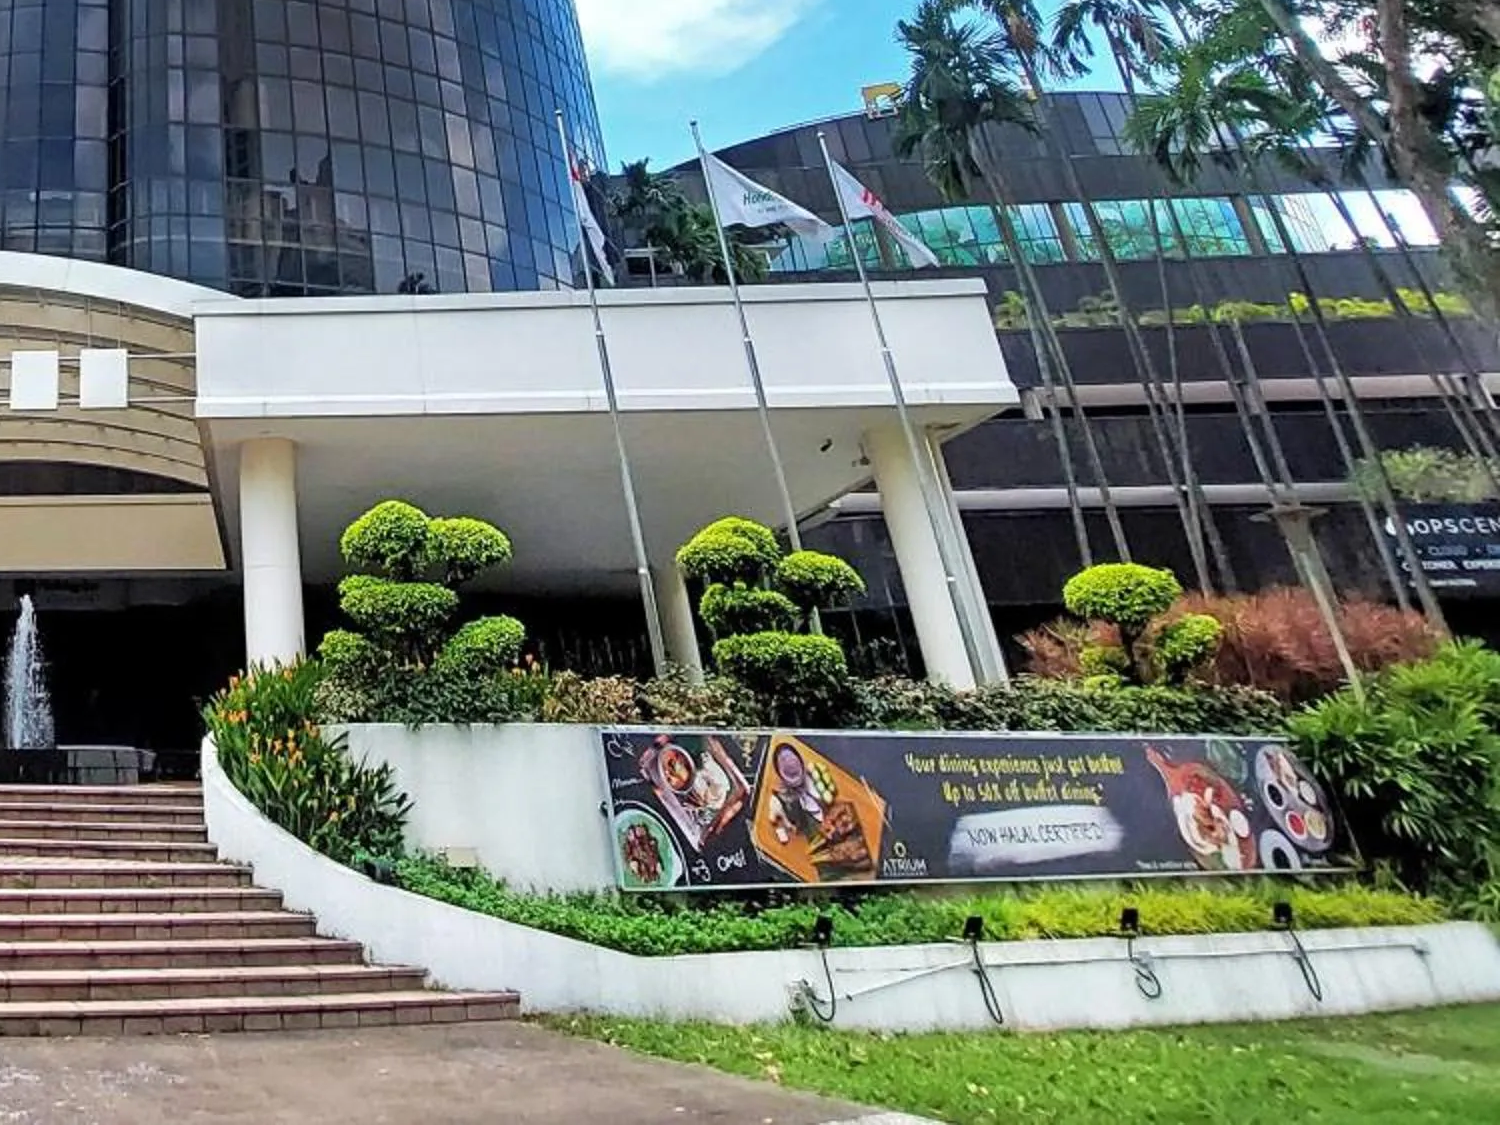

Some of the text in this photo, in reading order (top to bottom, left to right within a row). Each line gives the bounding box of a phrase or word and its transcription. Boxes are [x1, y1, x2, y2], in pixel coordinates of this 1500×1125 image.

[904, 752, 935, 773] Your
[938, 753, 979, 777] dining
[967, 827, 998, 847] NOW
[1000, 825, 1037, 843] HALAL
[884, 858, 928, 876] ATRIUM
